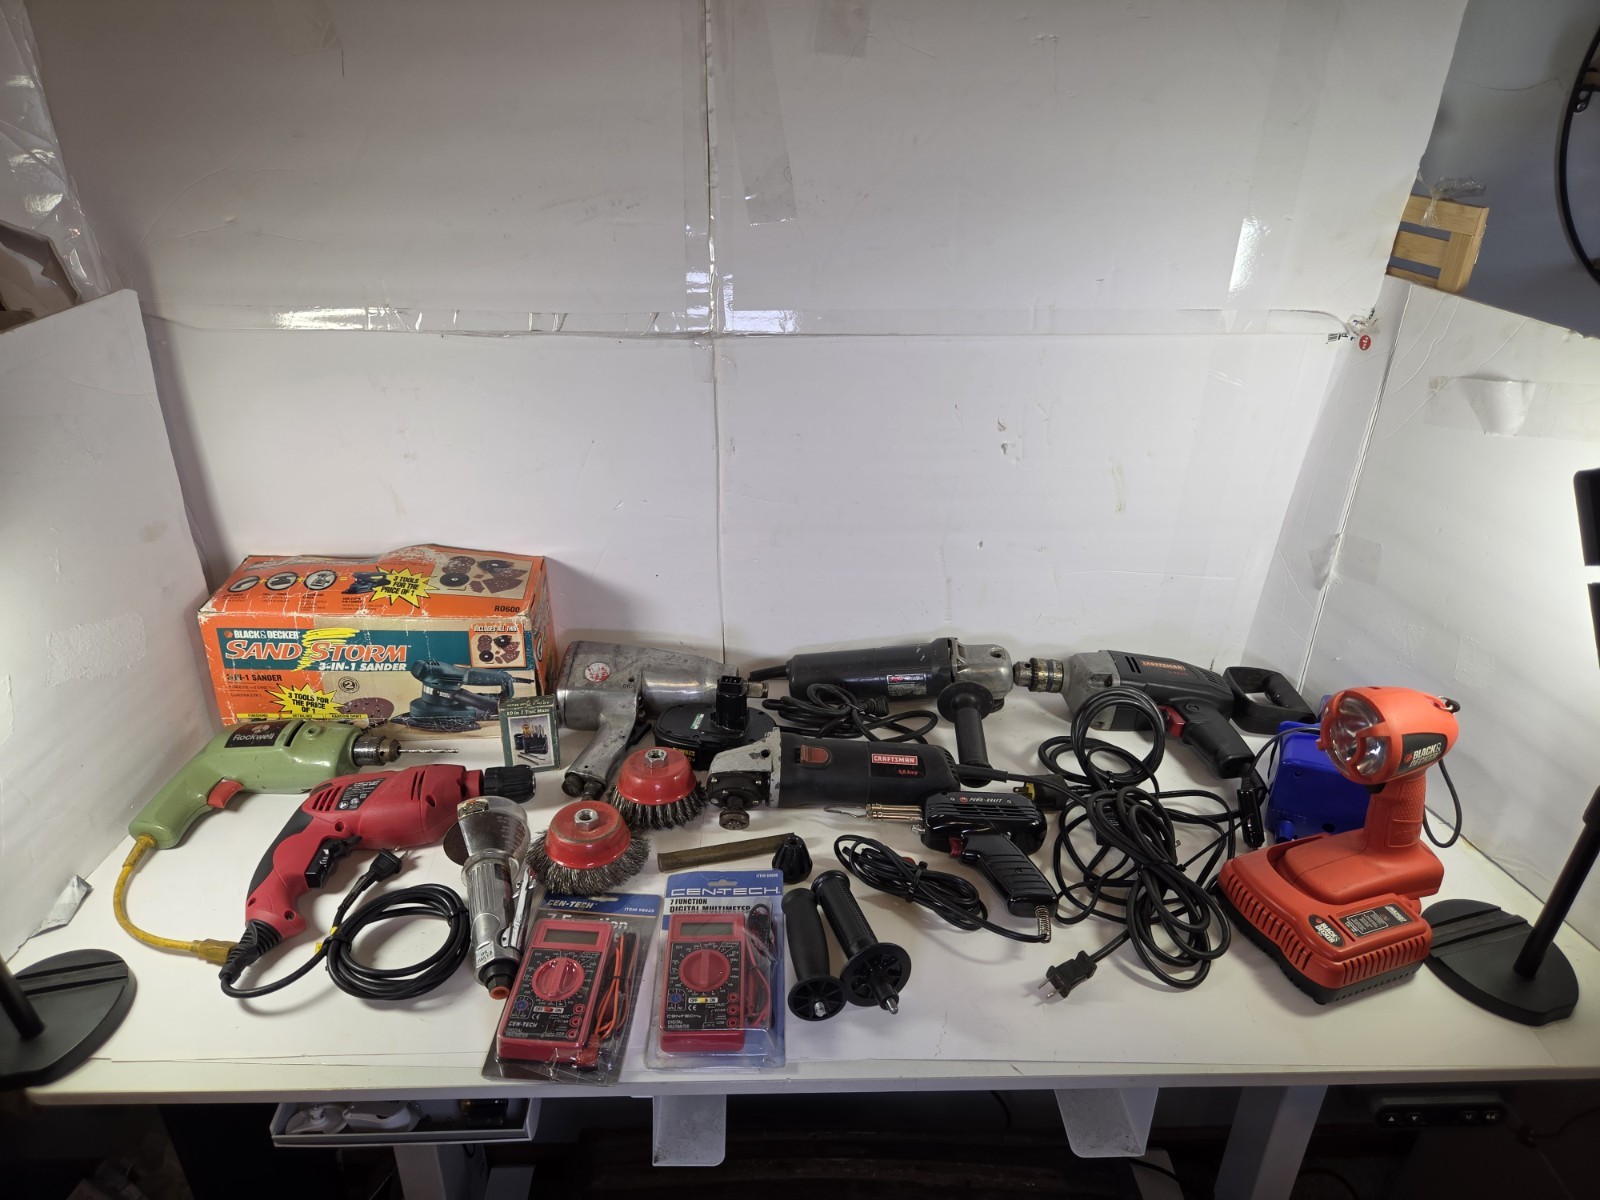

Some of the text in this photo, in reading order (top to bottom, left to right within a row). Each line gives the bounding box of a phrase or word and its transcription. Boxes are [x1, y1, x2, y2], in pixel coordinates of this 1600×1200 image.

[380, 586, 400, 594] PRICE
[225, 640, 407, 662] SAND STORM
[319, 662, 407, 671] 3-IN-1 SANDER
[294, 693, 314, 701] TOOLS
[316, 696, 329, 704] FOR
[292, 699, 325, 709] THE PRICE
[233, 732, 275, 741] Rockwell
[874, 755, 915, 763] CRAFTSMAN
[671, 887, 779, 896] CEN-TECH
[547, 899, 594, 909] CEN-TECH
[670, 905, 699, 913] DIGITAL
